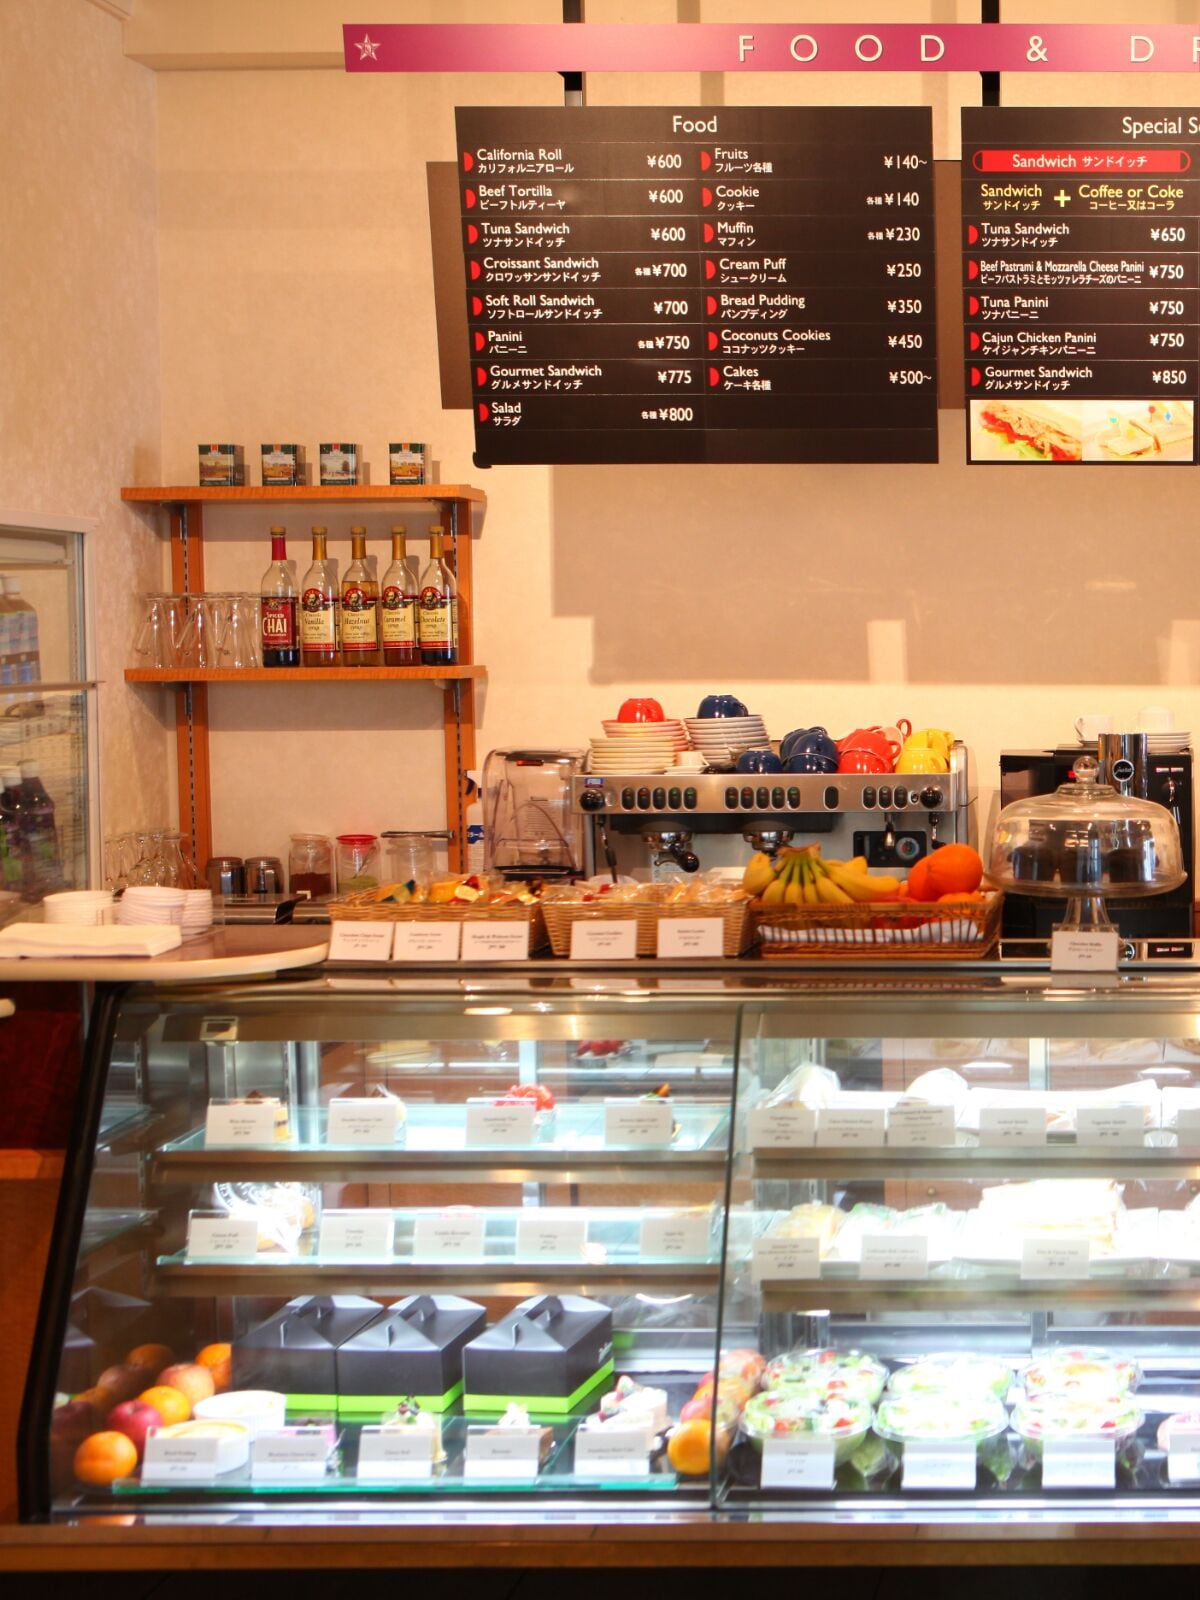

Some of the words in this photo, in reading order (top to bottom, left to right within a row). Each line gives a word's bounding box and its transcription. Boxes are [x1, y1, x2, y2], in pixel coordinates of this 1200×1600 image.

[739, 35, 944, 61] FOOD
[1027, 36, 1048, 61] &
[673, 116, 717, 132] Food
[1123, 117, 1181, 138] Special
[477, 149, 534, 160] California
[539, 149, 562, 160] Roll
[715, 148, 748, 159] Fruits
[647, 154, 681, 168] ¥600
[1013, 154, 1076, 167] Sandwich
[1082, 156, 1147, 167] サンドイッチ
[479, 185, 505, 196] Beef
[509, 185, 552, 196] Tortilla
[649, 189, 683, 203] ¥600
[716, 186, 759, 197] Cookie
[981, 184, 1042, 197] Sandwich
[1079, 185, 1123, 198] Coffee
[1127, 189, 1143, 198] or
[1148, 185, 1183, 198] Coke
[718, 201, 754, 211] クッキー
[481, 223, 511, 234] Tuna
[515, 223, 569, 234] Sandwich
[718, 222, 753, 233] Muffin
[981, 223, 1011, 234] Tuna
[1015, 223, 1069, 234] Sandwich
[651, 227, 685, 241] ¥600
[1151, 228, 1185, 241] ¥650
[483, 237, 565, 247] ツナサンドイッチ
[718, 238, 755, 247] マフィン
[484, 257, 540, 268] Croissant
[544, 257, 598, 268] Sandwich
[720, 258, 759, 269] Cream
[764, 258, 786, 269] Puff
[981, 261, 998, 271] Beef
[1001, 261, 1033, 271] Pastrami
[1036, 261, 1042, 271] &
[1045, 261, 1087, 272] Mozzarella
[1089, 261, 1118, 272] Cheese
[1121, 261, 1144, 272] Panini
[887, 264, 921, 277] ¥250
[1150, 265, 1184, 279] ¥750
[486, 272, 601, 282] クロワッサンサンドイッチ
[721, 273, 786, 283] シュークリーム
[486, 295, 509, 306] Soft
[514, 295, 536, 306] Roll
[540, 295, 594, 306] Sandwich
[721, 295, 754, 305] Bread
[759, 294, 805, 310] Pudding
[981, 296, 1010, 307] Tuna
[1015, 296, 1048, 307] Panini
[654, 301, 688, 314] ¥700
[888, 300, 921, 313] ¥350
[1150, 301, 1184, 315] ¥750
[488, 309, 602, 319] ソフトロールサンドイッチ
[488, 331, 522, 341] Panini
[722, 330, 778, 340] Coconuts
[783, 329, 830, 340] Cookies
[982, 332, 1013, 344] Cajun
[1017, 332, 1061, 342] Chicken
[1065, 332, 1096, 342] Panini
[1150, 333, 1184, 347] ¥750
[888, 335, 922, 348] ¥450
[490, 365, 544, 376] Gourmet
[548, 365, 602, 376] Sandwich
[723, 366, 758, 377] Cakes
[985, 367, 1035, 377] Gourmet
[1039, 367, 1092, 377] Sandwich
[658, 370, 691, 383] ¥775
[1153, 370, 1186, 384] ¥850
[492, 402, 521, 413] Salad
[262, 617, 287, 636] CHAI
